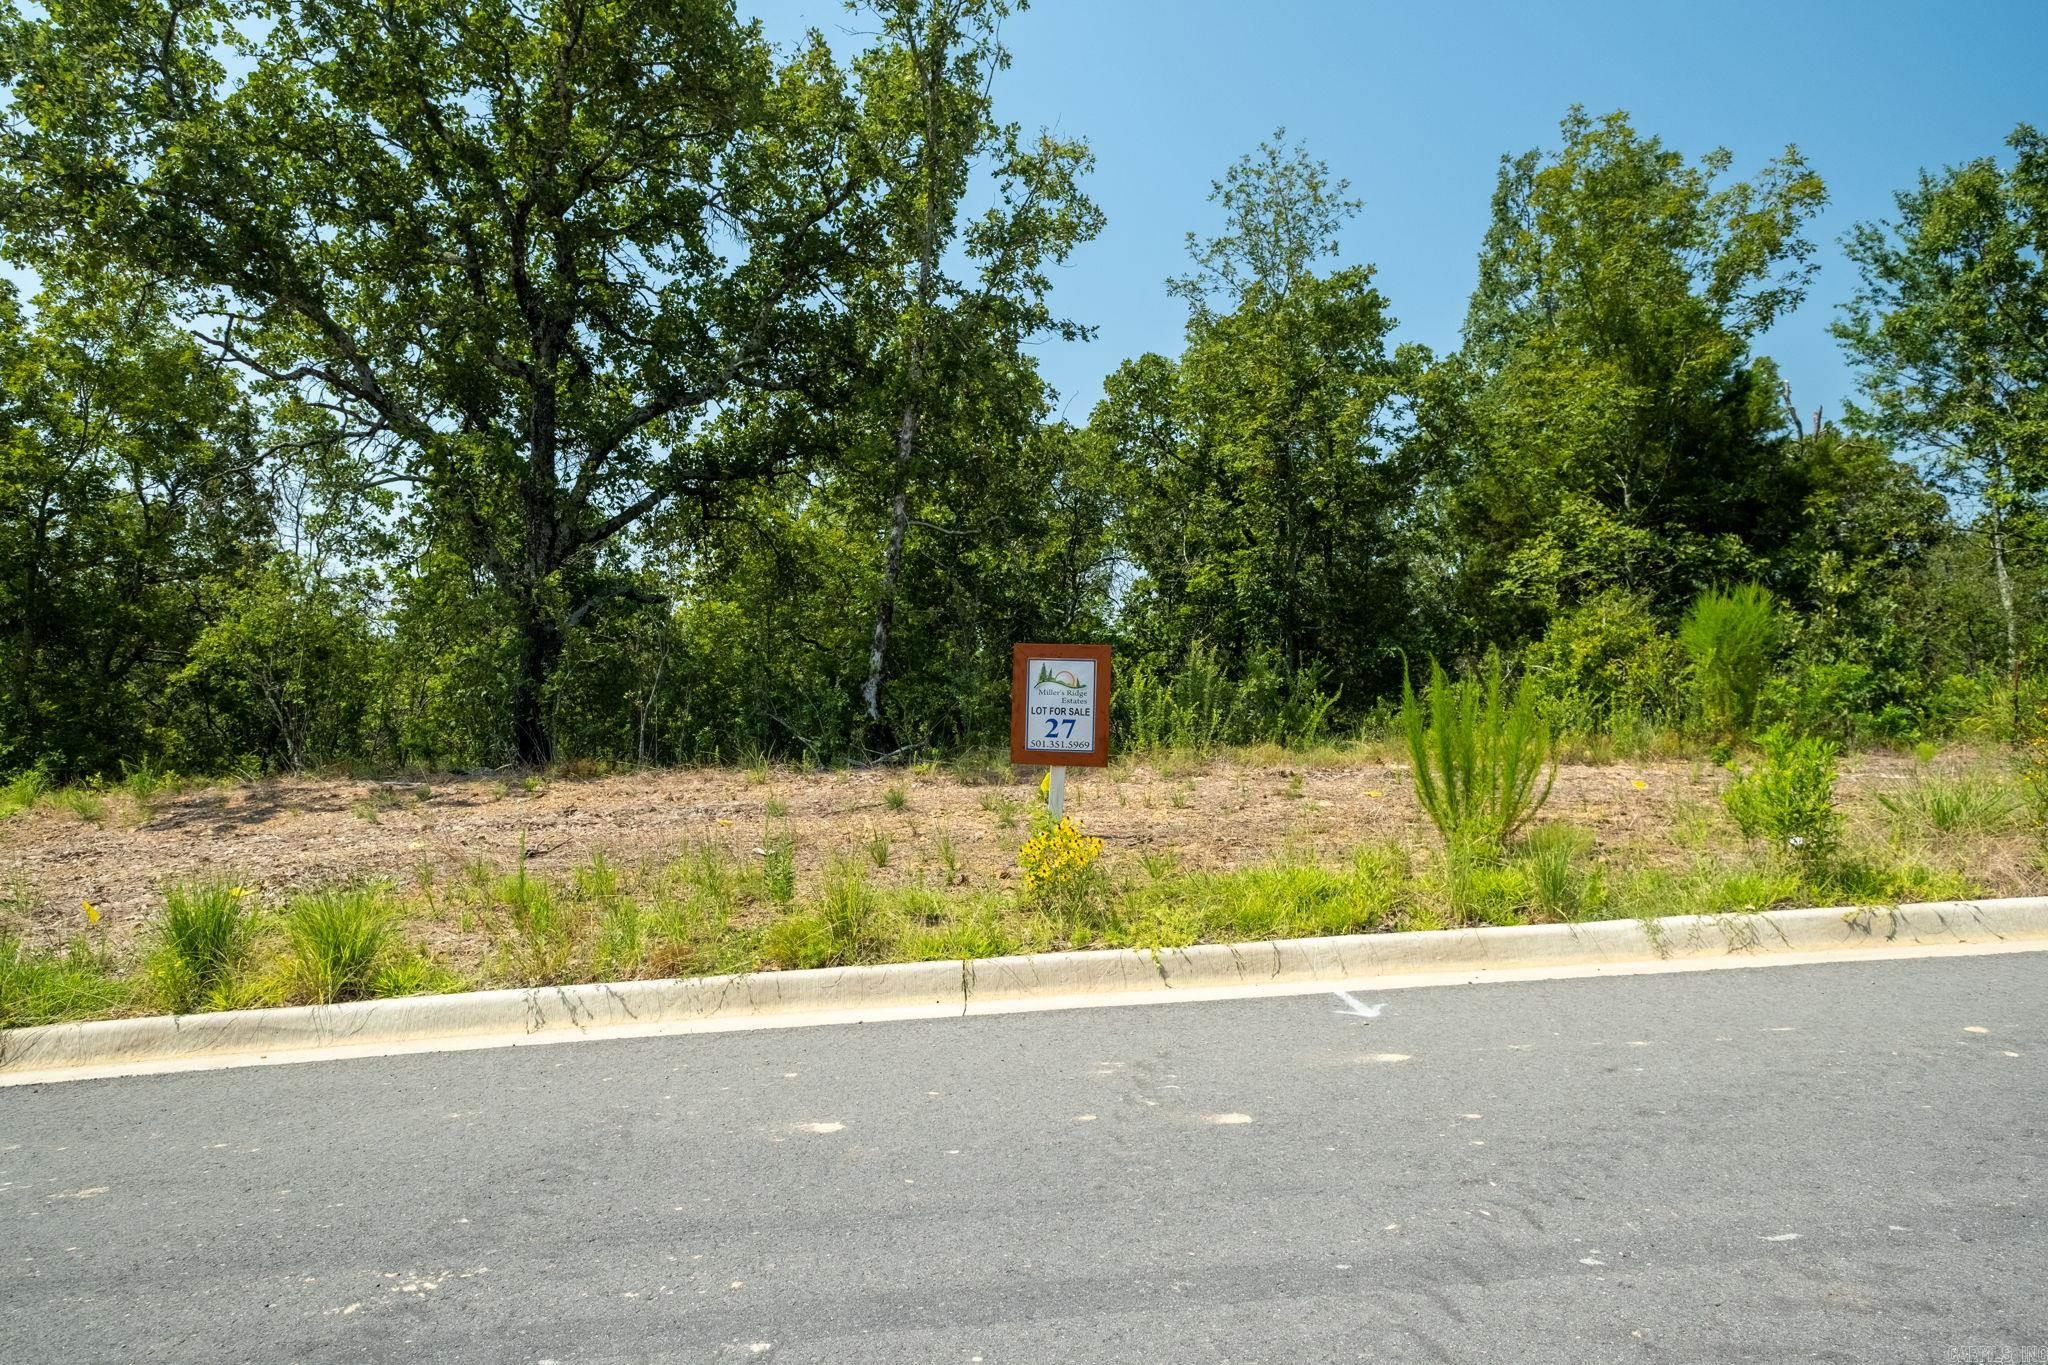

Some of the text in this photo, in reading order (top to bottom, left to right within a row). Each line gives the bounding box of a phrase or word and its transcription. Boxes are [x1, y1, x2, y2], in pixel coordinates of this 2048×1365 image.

[1066, 690, 1088, 698] Ridge
[1031, 706, 1090, 717] LOT FOR SALE
[1044, 718, 1076, 739] 27
[1030, 740, 1090, 749] 501.351.5969
